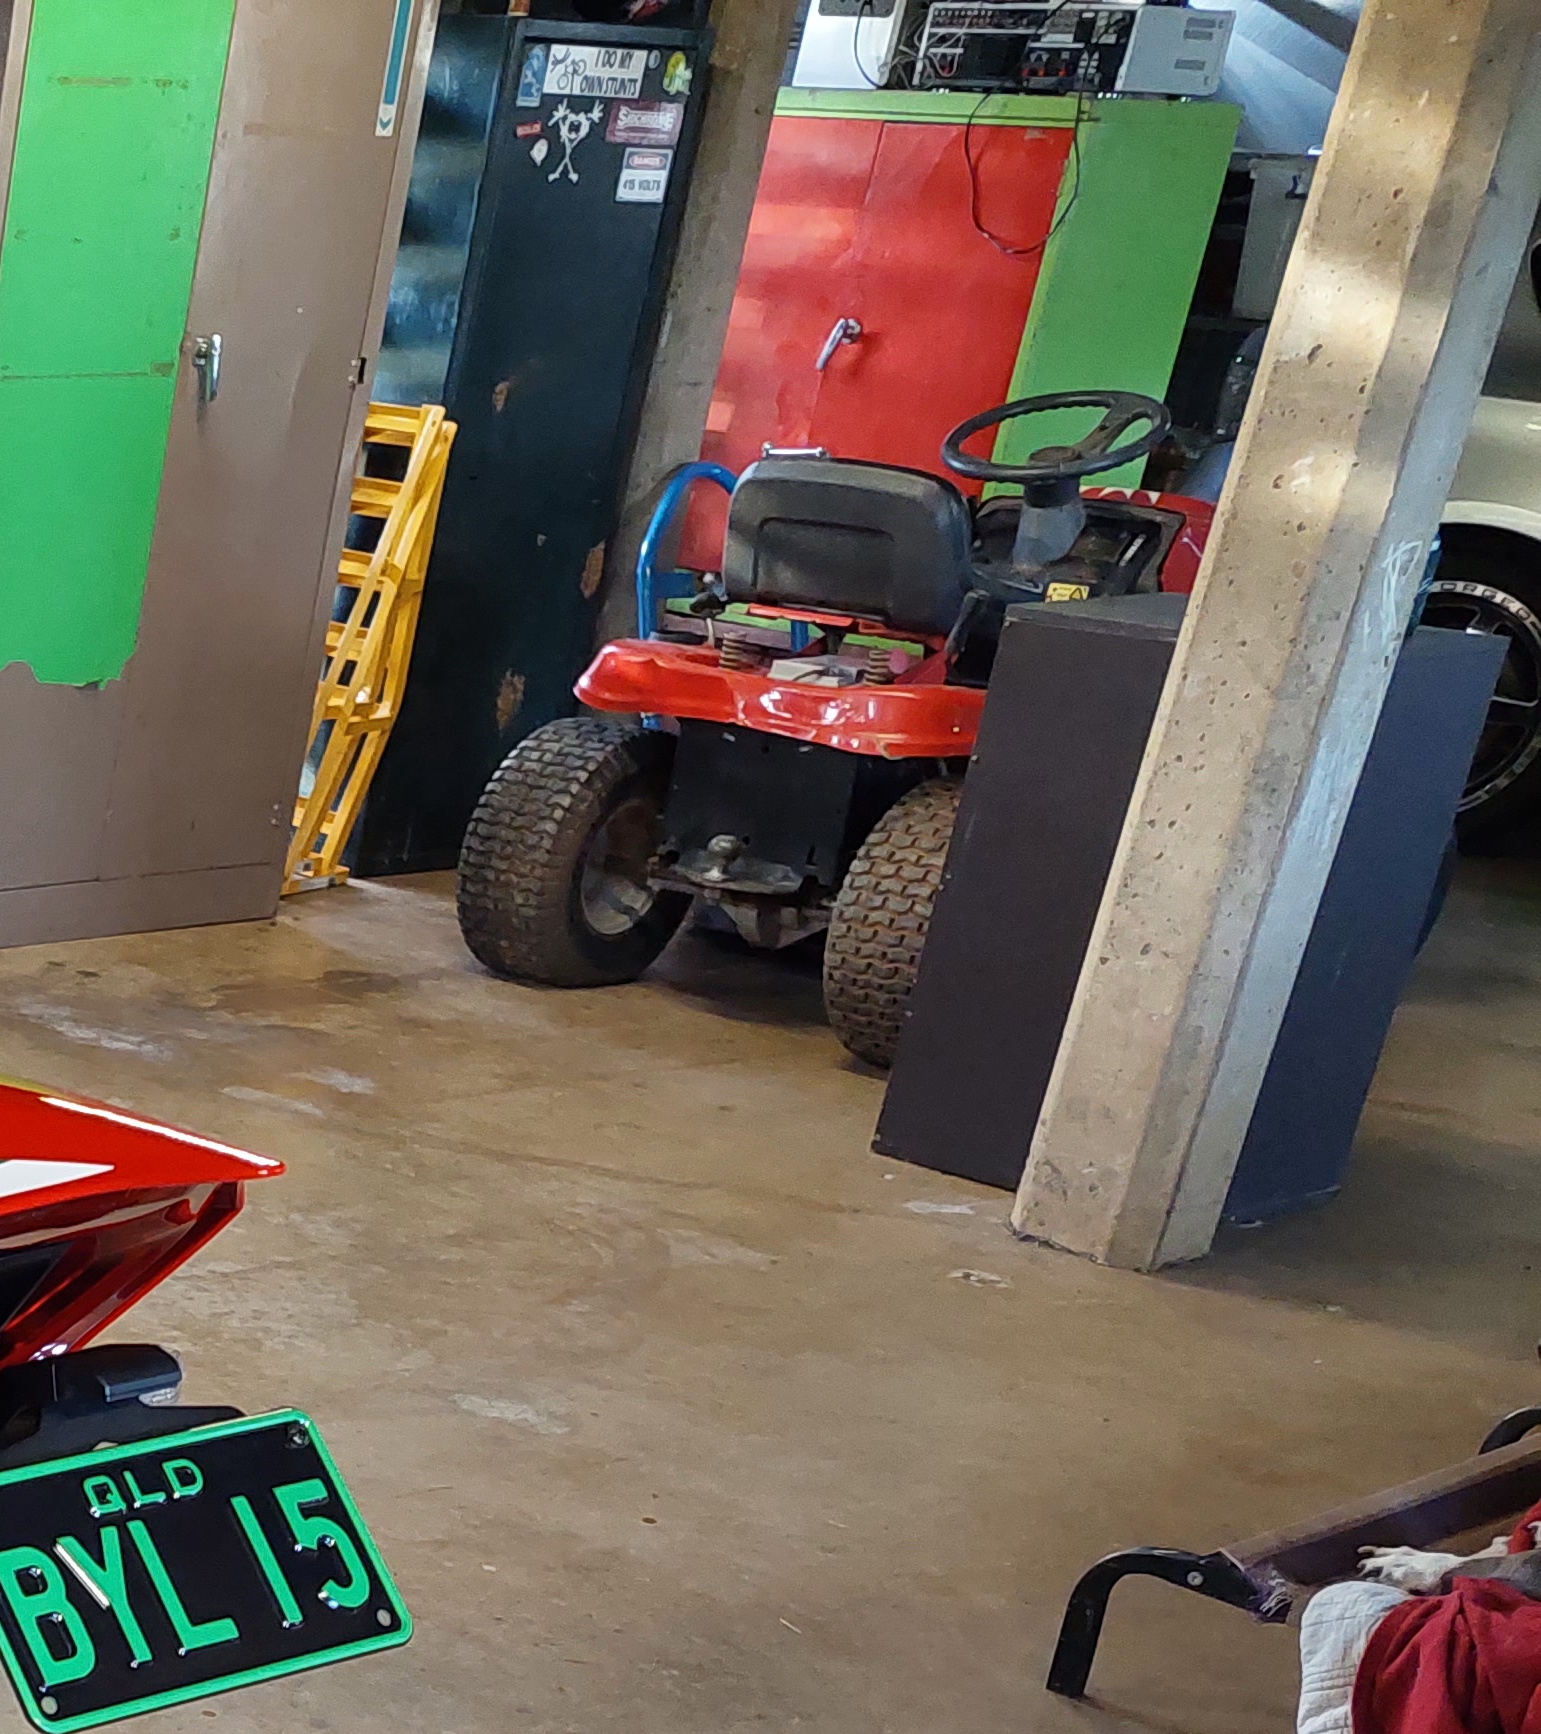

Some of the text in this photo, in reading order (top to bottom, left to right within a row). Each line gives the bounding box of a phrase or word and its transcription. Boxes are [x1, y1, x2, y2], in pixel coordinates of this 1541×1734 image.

[594, 48, 635, 70] I DO MY
[579, 74, 639, 96] OWN STUNTS
[82, 1457, 205, 1516] QLD
[230, 1478, 371, 1628] 15
